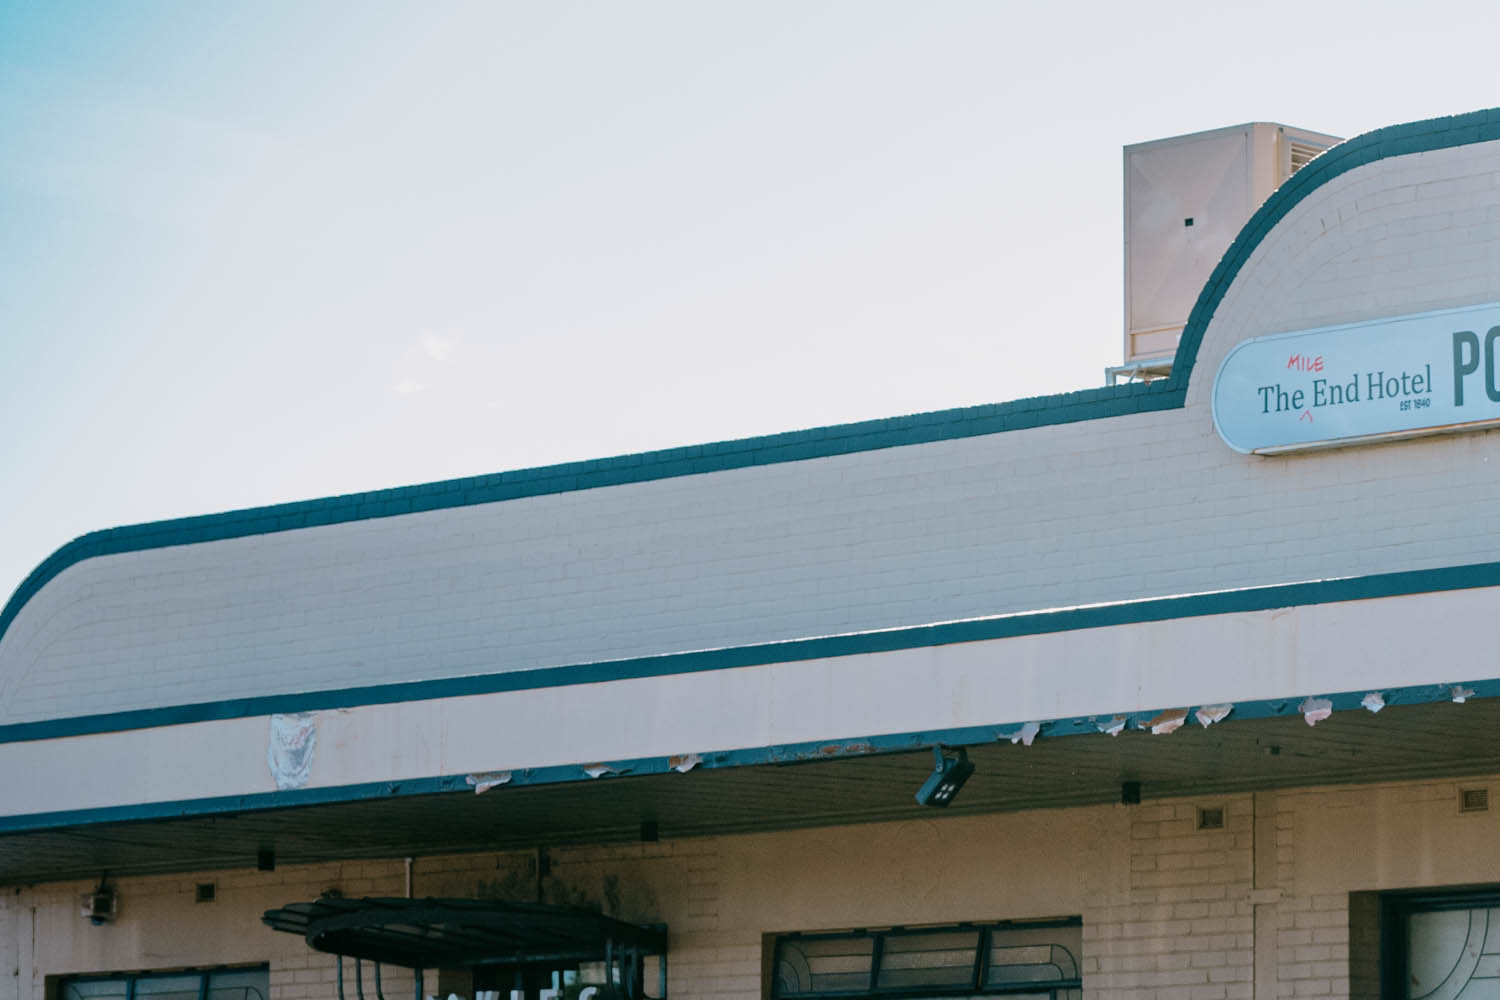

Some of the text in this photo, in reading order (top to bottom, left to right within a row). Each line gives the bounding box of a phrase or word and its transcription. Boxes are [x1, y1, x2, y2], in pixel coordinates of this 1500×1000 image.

[1287, 353, 1324, 373] MILE
[1257, 363, 1433, 414] The End Hotel
